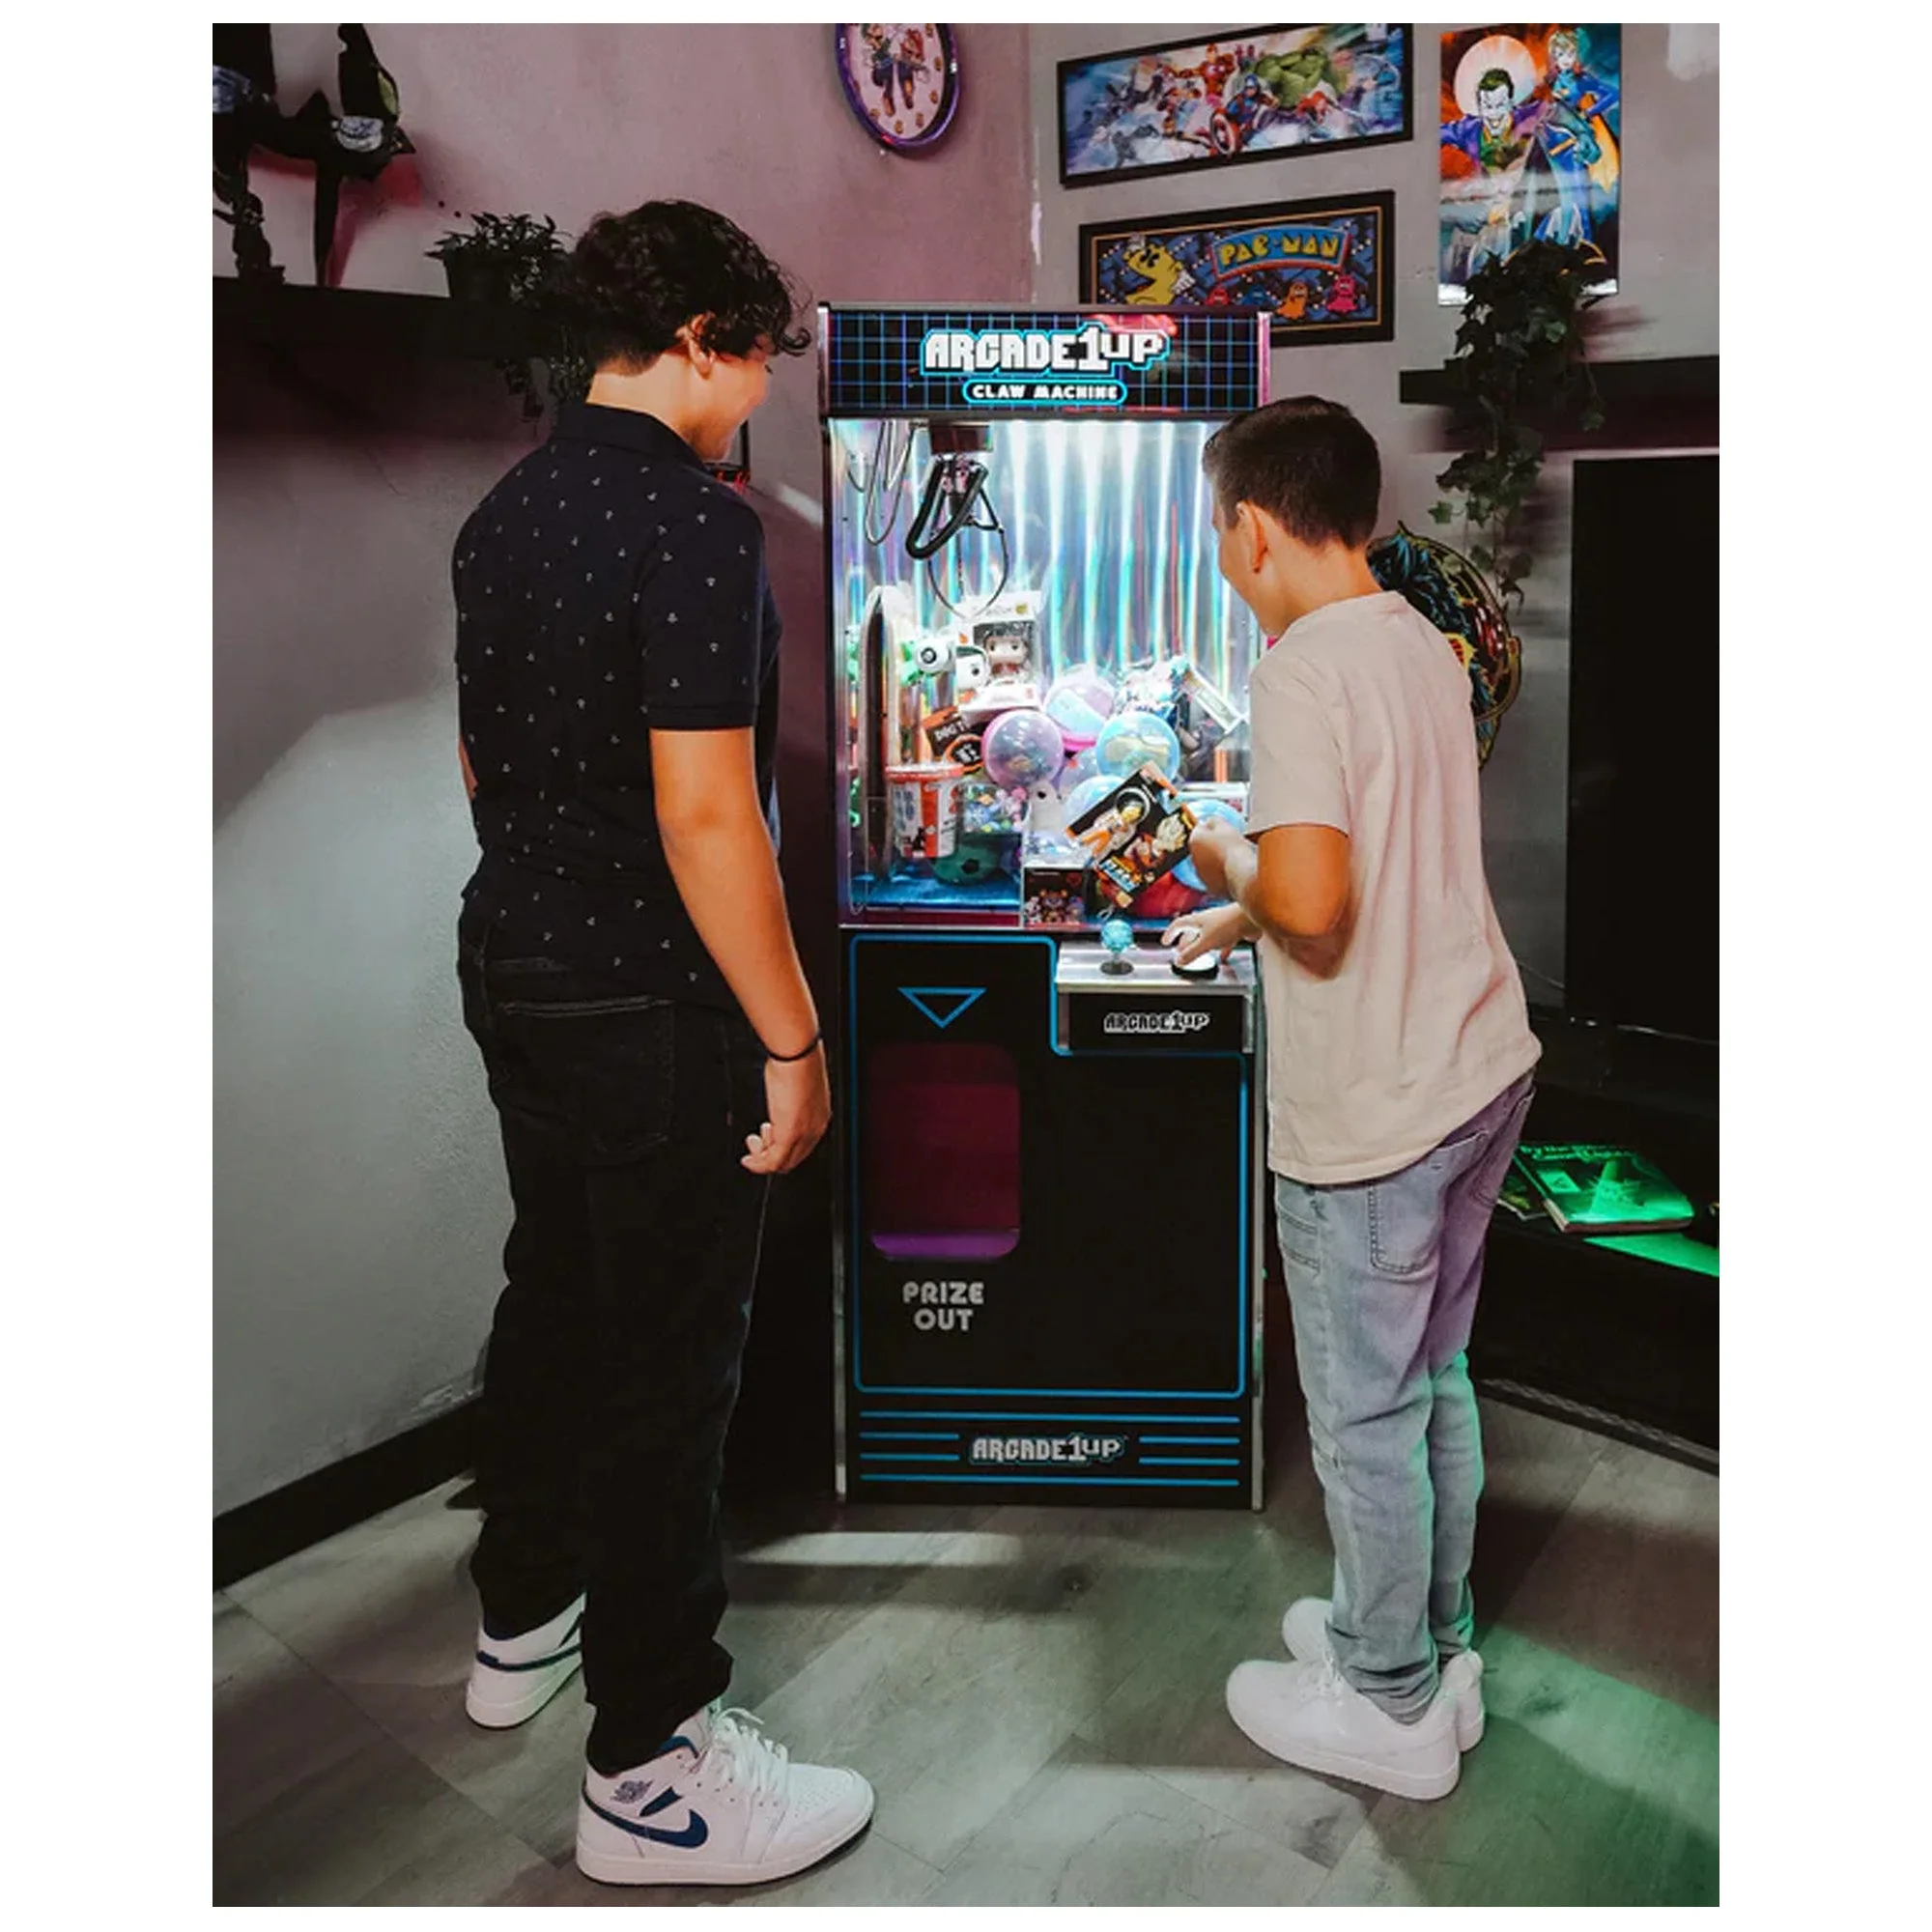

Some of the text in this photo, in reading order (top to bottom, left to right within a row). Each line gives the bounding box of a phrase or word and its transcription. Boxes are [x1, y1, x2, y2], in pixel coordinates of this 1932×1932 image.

[1219, 233, 1339, 267] PAC-MAN
[972, 384, 1119, 401] CLAW MACHINE
[902, 1280, 985, 1304] PRIZE
[913, 1307, 974, 1332] OUT
